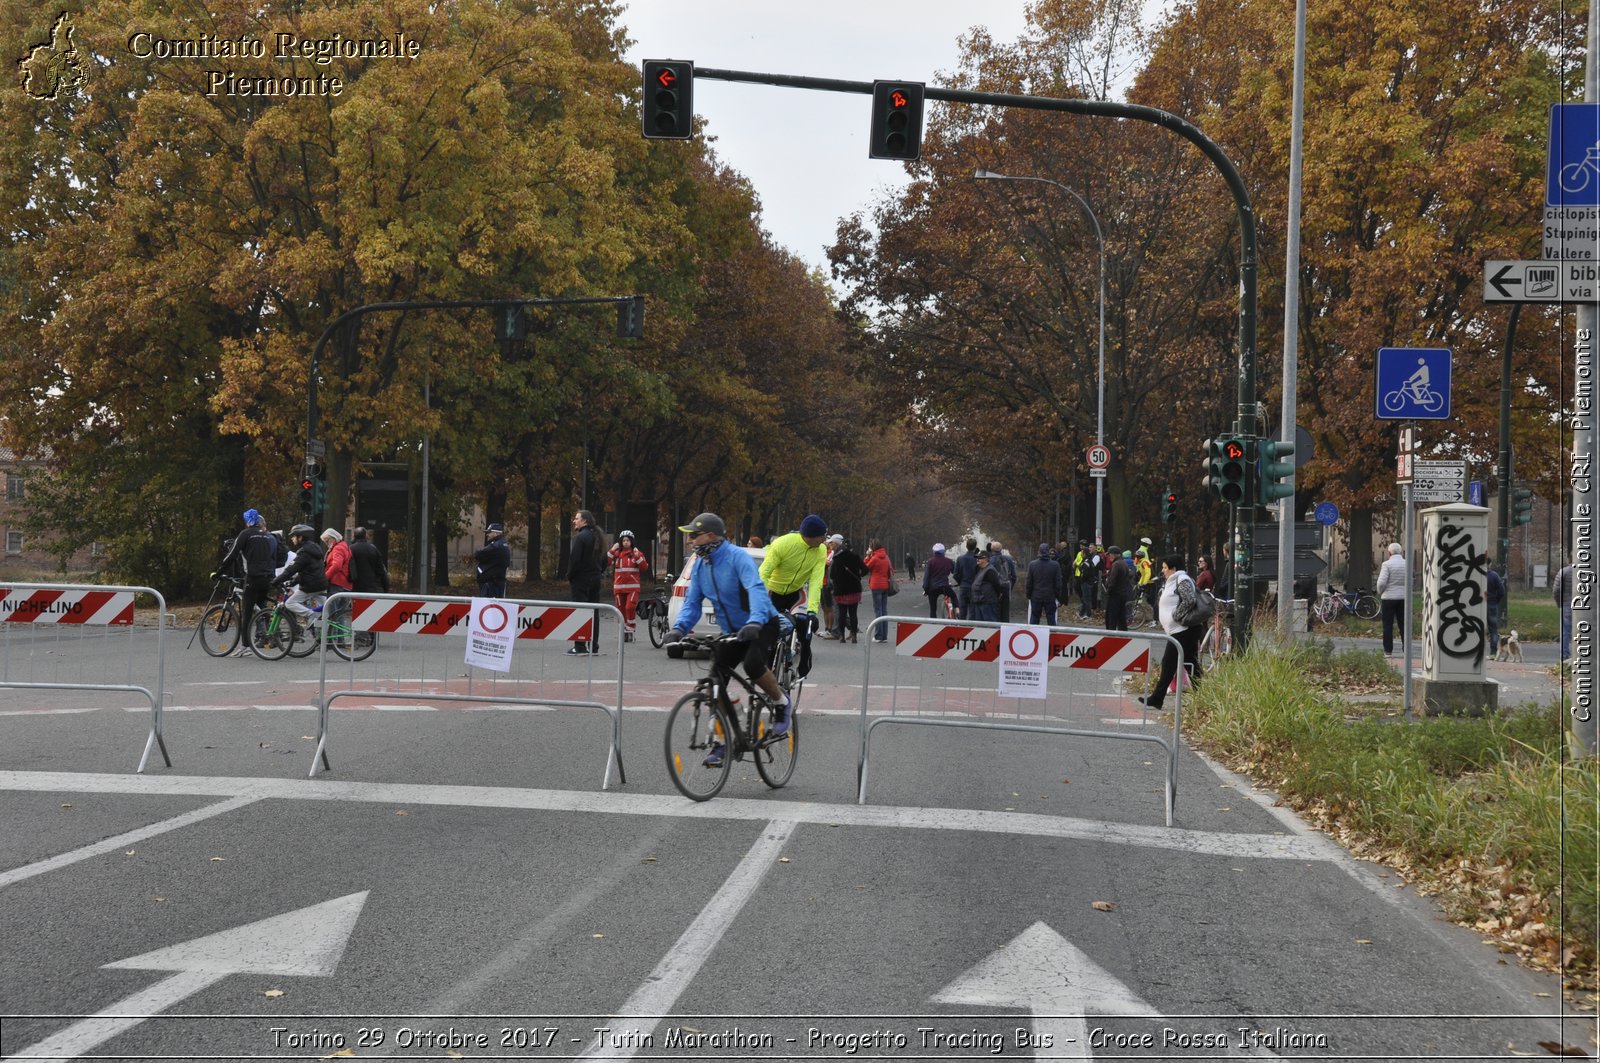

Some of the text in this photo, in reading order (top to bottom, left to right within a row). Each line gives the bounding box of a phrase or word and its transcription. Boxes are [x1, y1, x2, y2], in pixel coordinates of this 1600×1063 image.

[1545, 247, 1591, 258] Vallere
[1569, 286, 1592, 297] via
[1093, 451, 1105, 463] 50
[2, 600, 84, 614] NICHELINO
[448, 616, 459, 627] di
